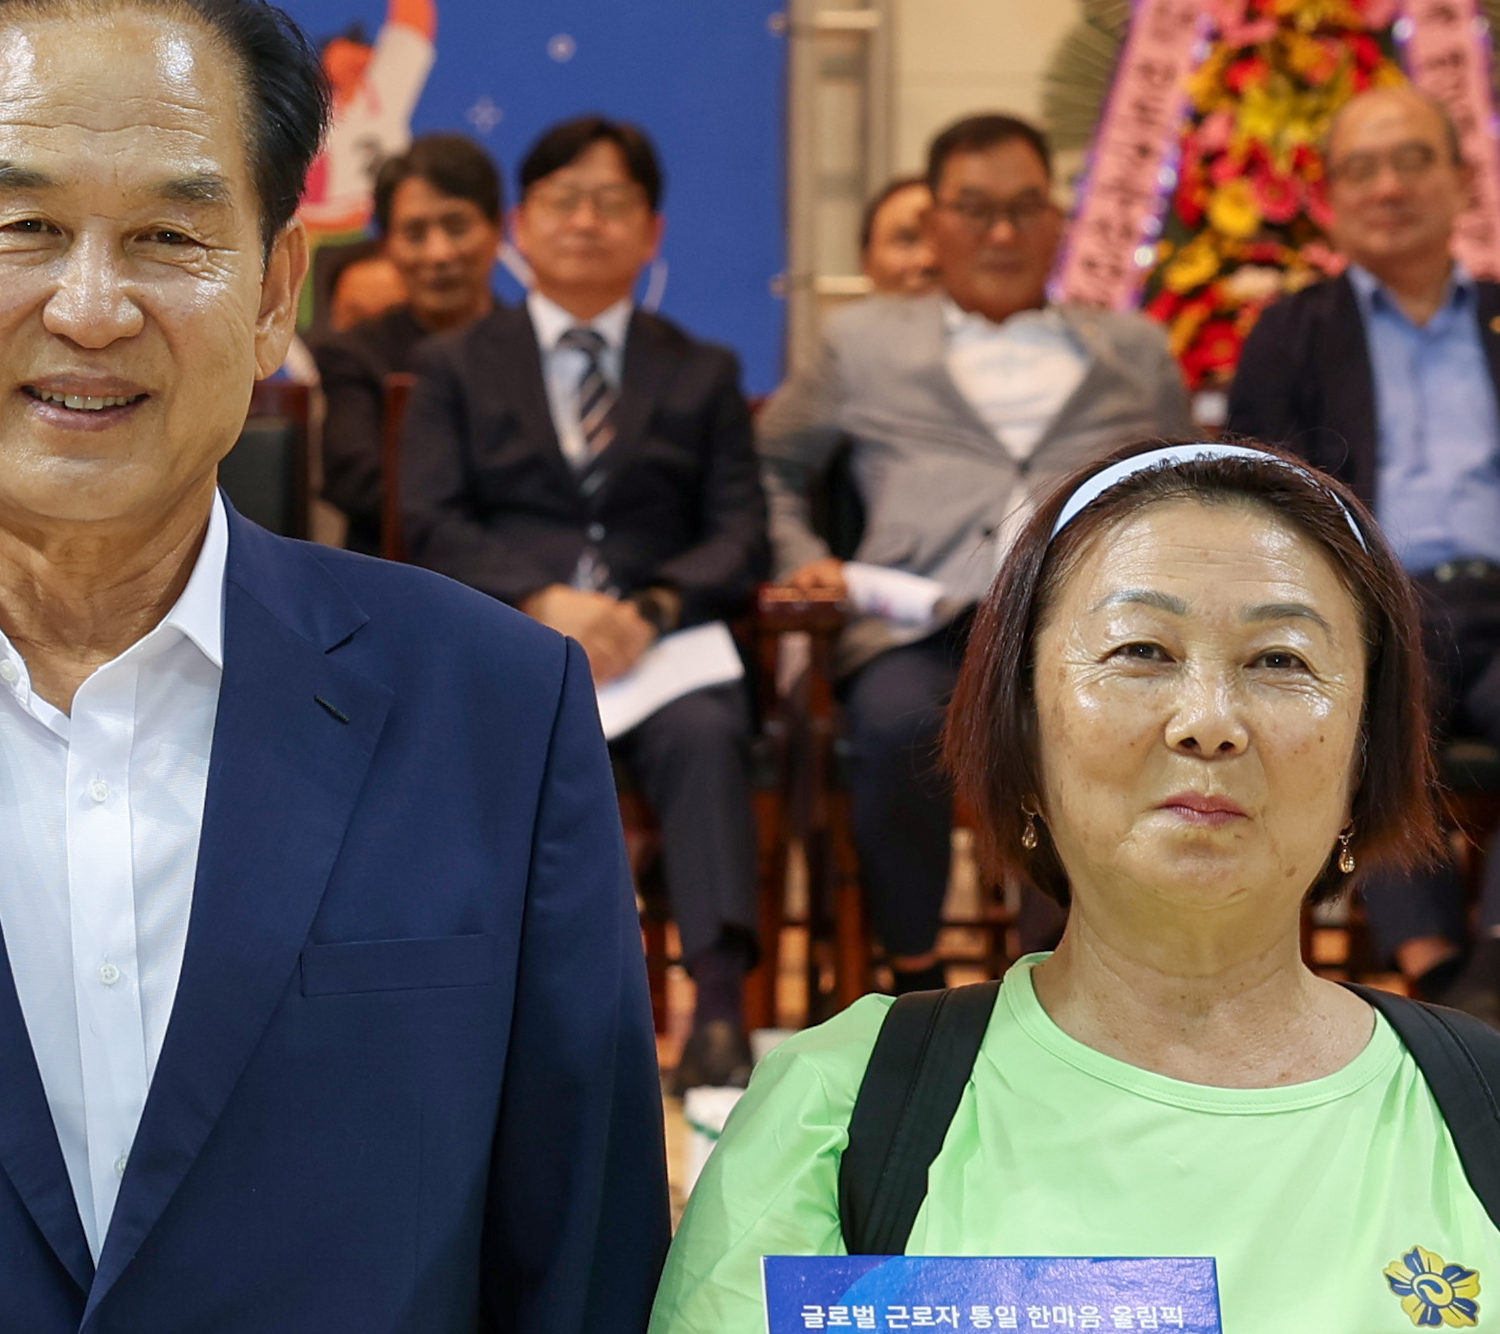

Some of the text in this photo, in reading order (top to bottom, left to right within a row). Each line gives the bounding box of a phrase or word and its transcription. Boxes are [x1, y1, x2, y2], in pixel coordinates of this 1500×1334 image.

[800, 1304, 1185, 1330] 글로벌 근로자 통일 한마음 올림픽
